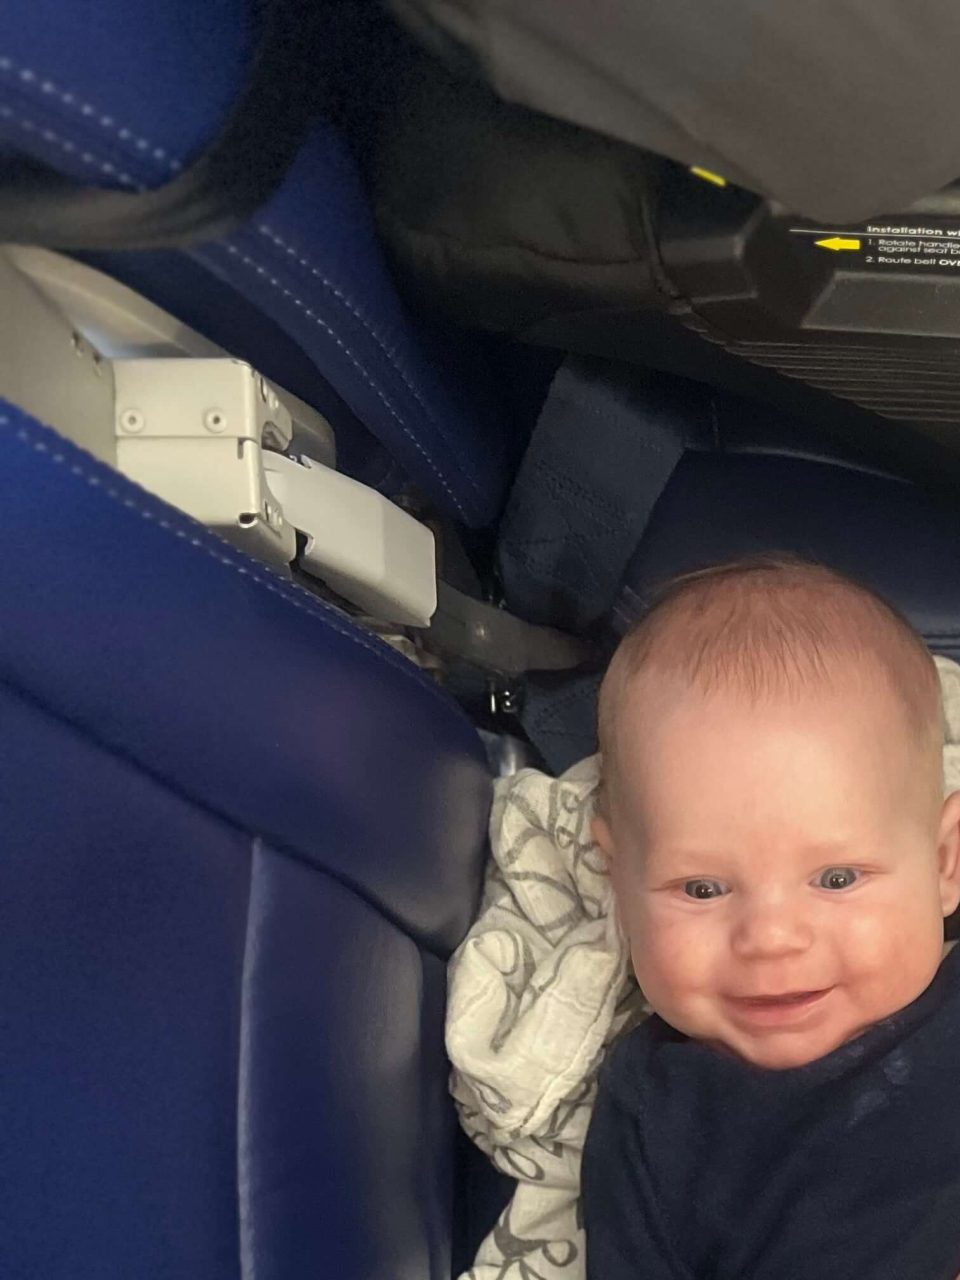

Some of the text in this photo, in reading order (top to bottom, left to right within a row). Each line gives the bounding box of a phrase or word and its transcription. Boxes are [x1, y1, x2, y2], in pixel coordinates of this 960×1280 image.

[867, 225, 943, 236] Installation
[878, 239, 916, 247] Rotate
[919, 241, 960, 249] handle
[878, 256, 912, 265] Route
